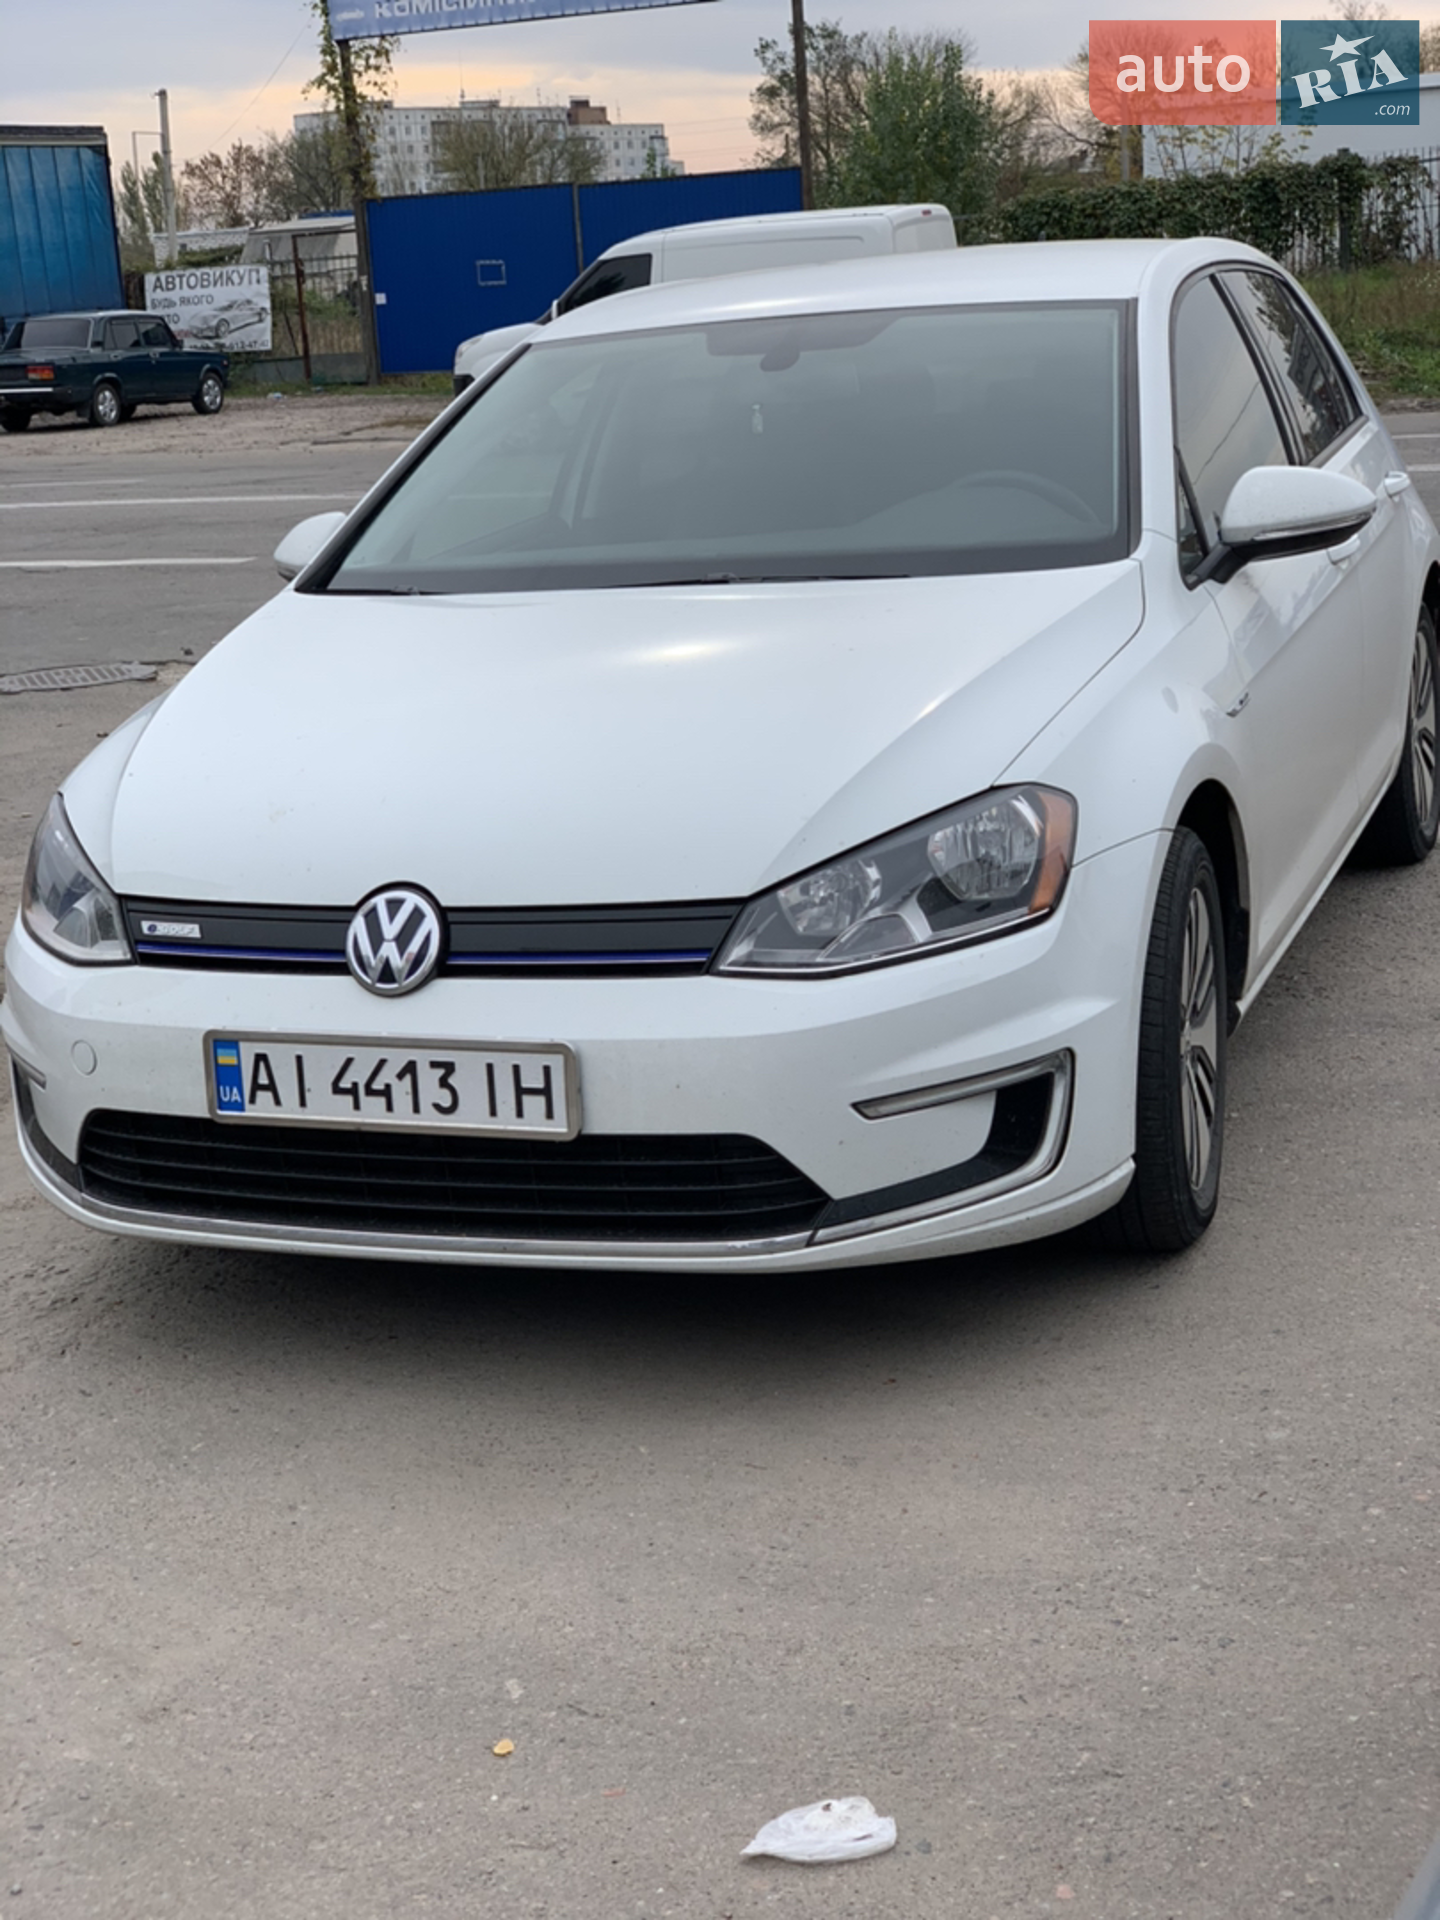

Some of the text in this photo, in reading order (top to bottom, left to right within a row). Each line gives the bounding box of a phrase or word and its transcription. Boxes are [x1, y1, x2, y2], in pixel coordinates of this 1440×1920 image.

[152, 267, 261, 292] АВТОВИКУП
[150, 294, 214, 310] БУДЬ ЯКОГО
[219, 1085, 241, 1103] UA
[249, 1052, 555, 1120] AI 4413 IH
